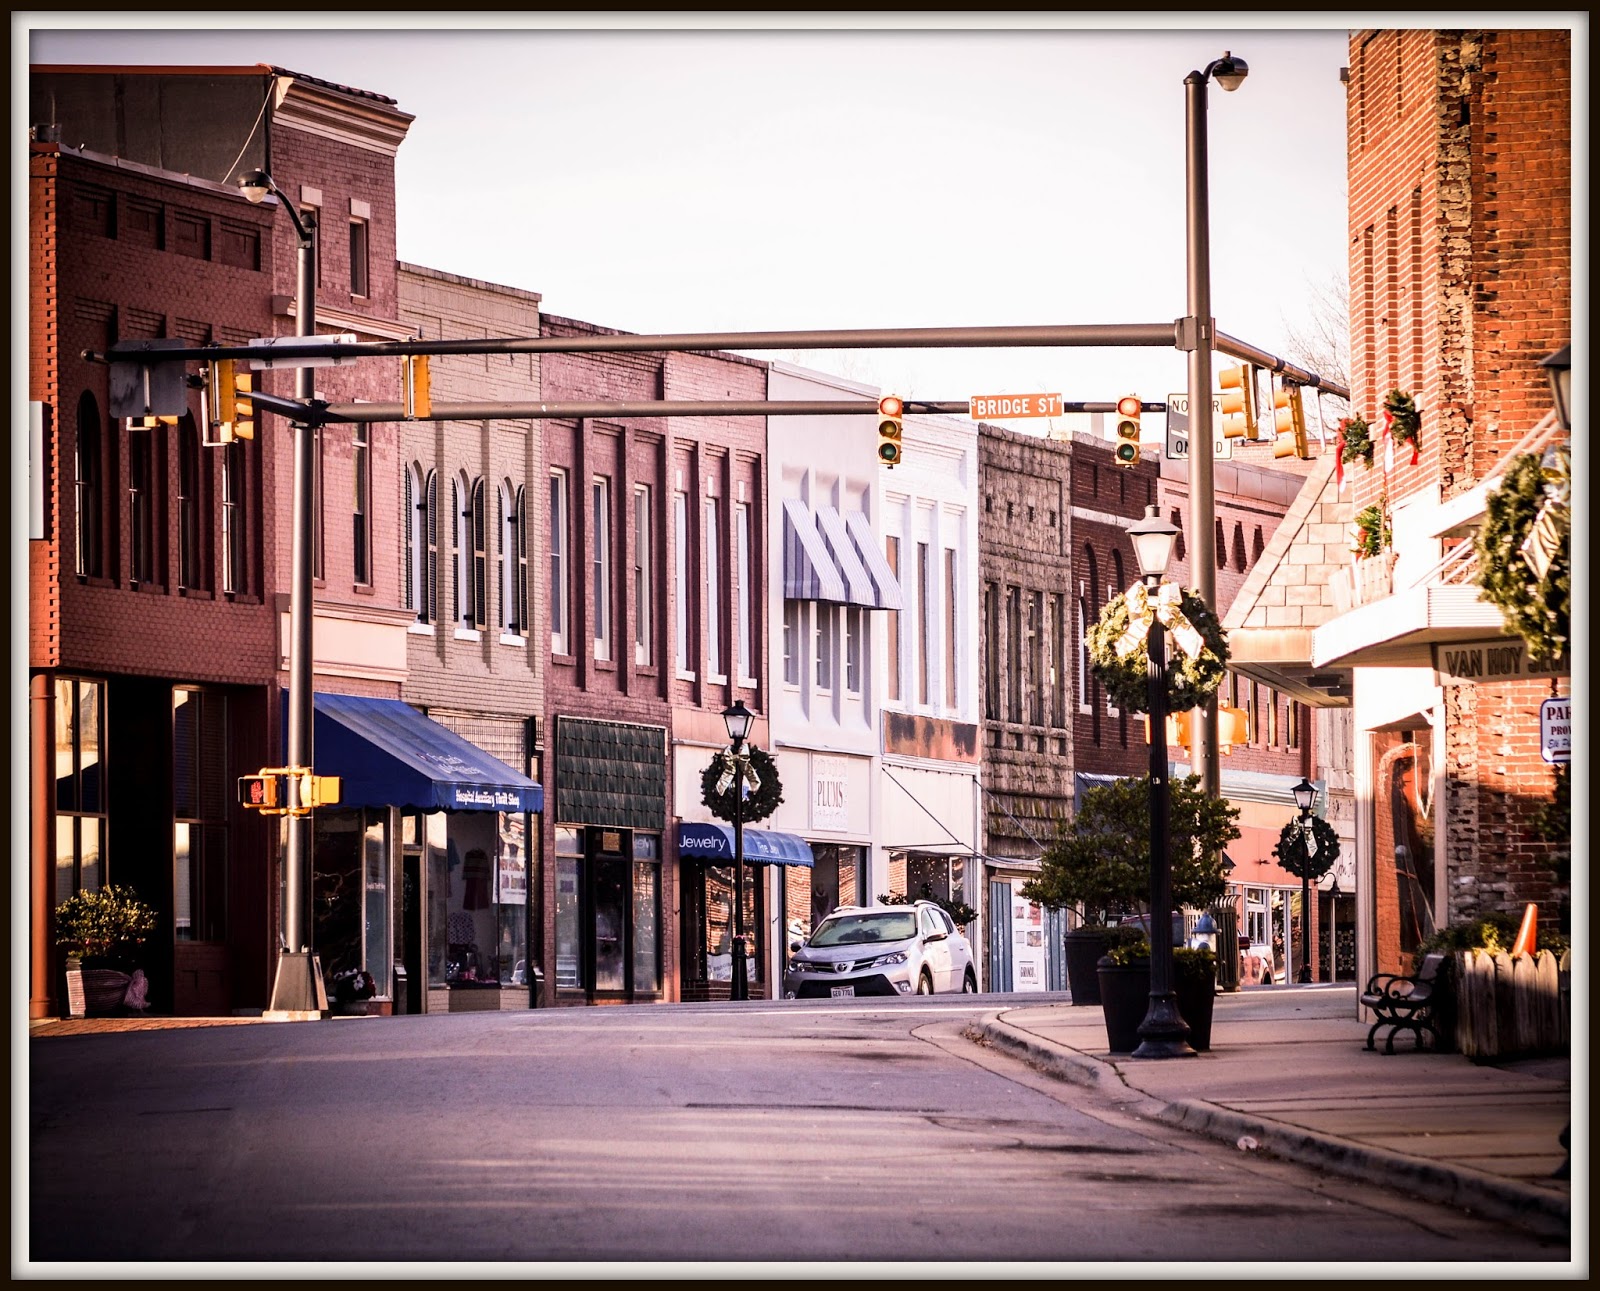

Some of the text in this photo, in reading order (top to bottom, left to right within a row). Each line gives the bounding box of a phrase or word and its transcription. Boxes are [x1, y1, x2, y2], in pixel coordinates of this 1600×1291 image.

[977, 399, 1030, 415] BRIDGE
[1038, 397, 1055, 413] ST
[1172, 400, 1188, 412] NO
[1445, 649, 1483, 677] VAN
[1488, 647, 1523, 675] HOY
[456, 790, 519, 808] Hospital Auxiliary Thrift Shop
[817, 780, 843, 808] PLUMS
[679, 834, 726, 852] Jewelry
